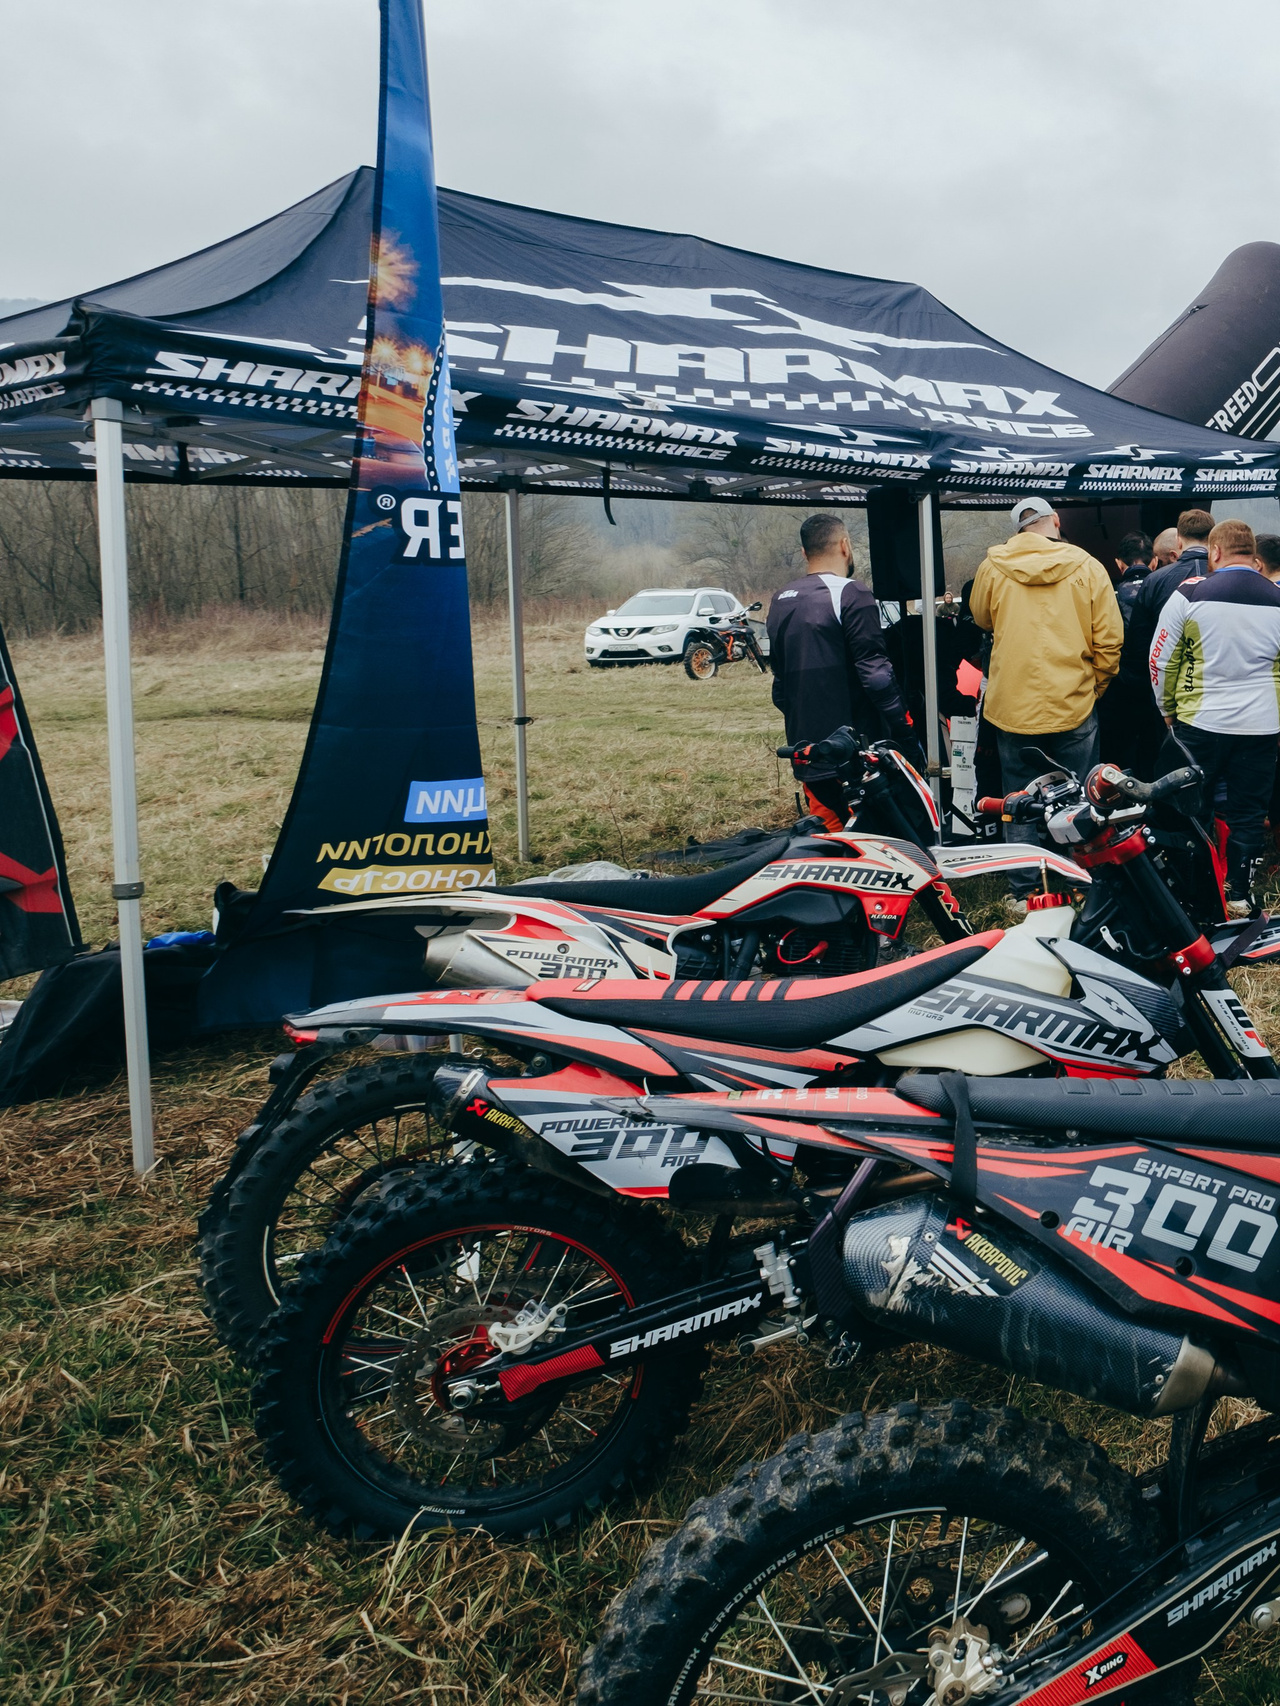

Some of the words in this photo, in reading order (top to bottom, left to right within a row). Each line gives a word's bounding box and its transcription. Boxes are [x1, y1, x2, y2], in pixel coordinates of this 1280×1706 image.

[506, 399, 739, 448] SHARMAX
[923, 408, 1094, 438] RACE
[654, 442, 731, 461] RACE
[762, 437, 933, 469] SHARMAX
[869, 467, 926, 481] RACE
[950, 460, 1076, 477] SHARMAX
[1083, 464, 1185, 481] SHARMAX
[1194, 468, 1280, 482] SHARMAX
[1025, 478, 1067, 490] RACE
[1148, 483, 1183, 492] RACE
[1249, 483, 1277, 492] RACE
[761, 864, 917, 893] SHARMAX
[505, 949, 619, 969] POWERMAX
[538, 961, 607, 979] 300
[914, 983, 1165, 1062] SHARMAX
[569, 1125, 710, 1161] 300
[661, 1154, 700, 1168] AIR
[1132, 1157, 1227, 1195] EXPERT
[1227, 1184, 1277, 1212] PRO
[513, 1224, 553, 1236] MOTORS
[1072, 1165, 1278, 1273] 300
[1064, 1217, 1134, 1254] AIR
[964, 1232, 1029, 1288] AKRAPOVIČ
[609, 1292, 762, 1359] SHARMAX
[803, 1524, 846, 1551] RACE
[700, 1549, 798, 1644] PERFORMANS
[1166, 1541, 1278, 1628] SHARMAX
